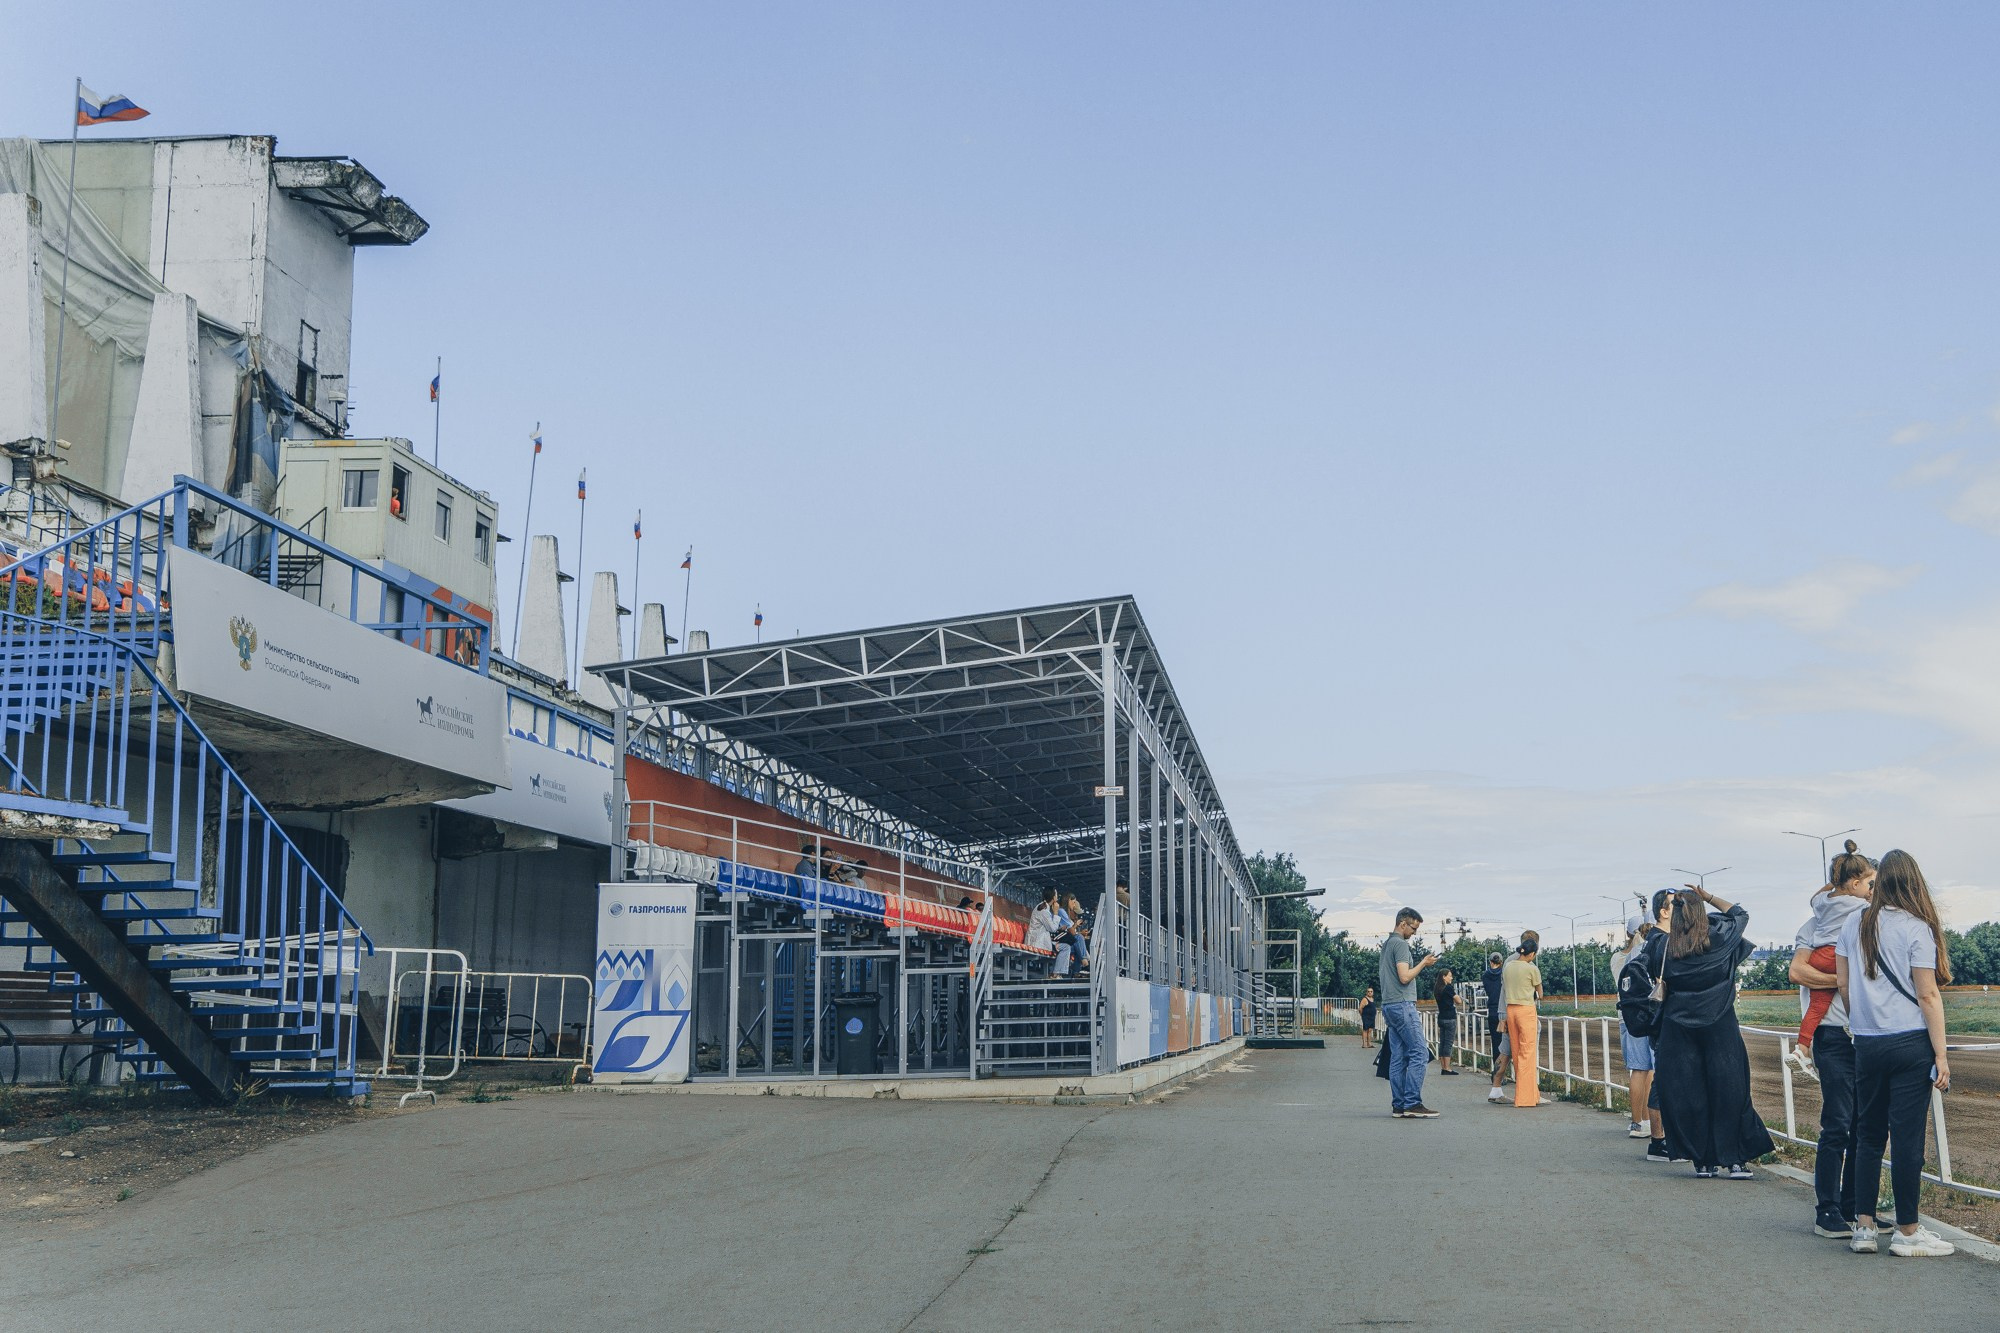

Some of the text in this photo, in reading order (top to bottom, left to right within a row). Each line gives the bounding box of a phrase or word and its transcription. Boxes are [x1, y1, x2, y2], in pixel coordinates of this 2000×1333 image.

[264, 640, 360, 684] Министерство сельского хозяйства
[265, 657, 331, 691] Российской Федерации
[628, 906, 687, 914] ГАЗПРОМБАНК
